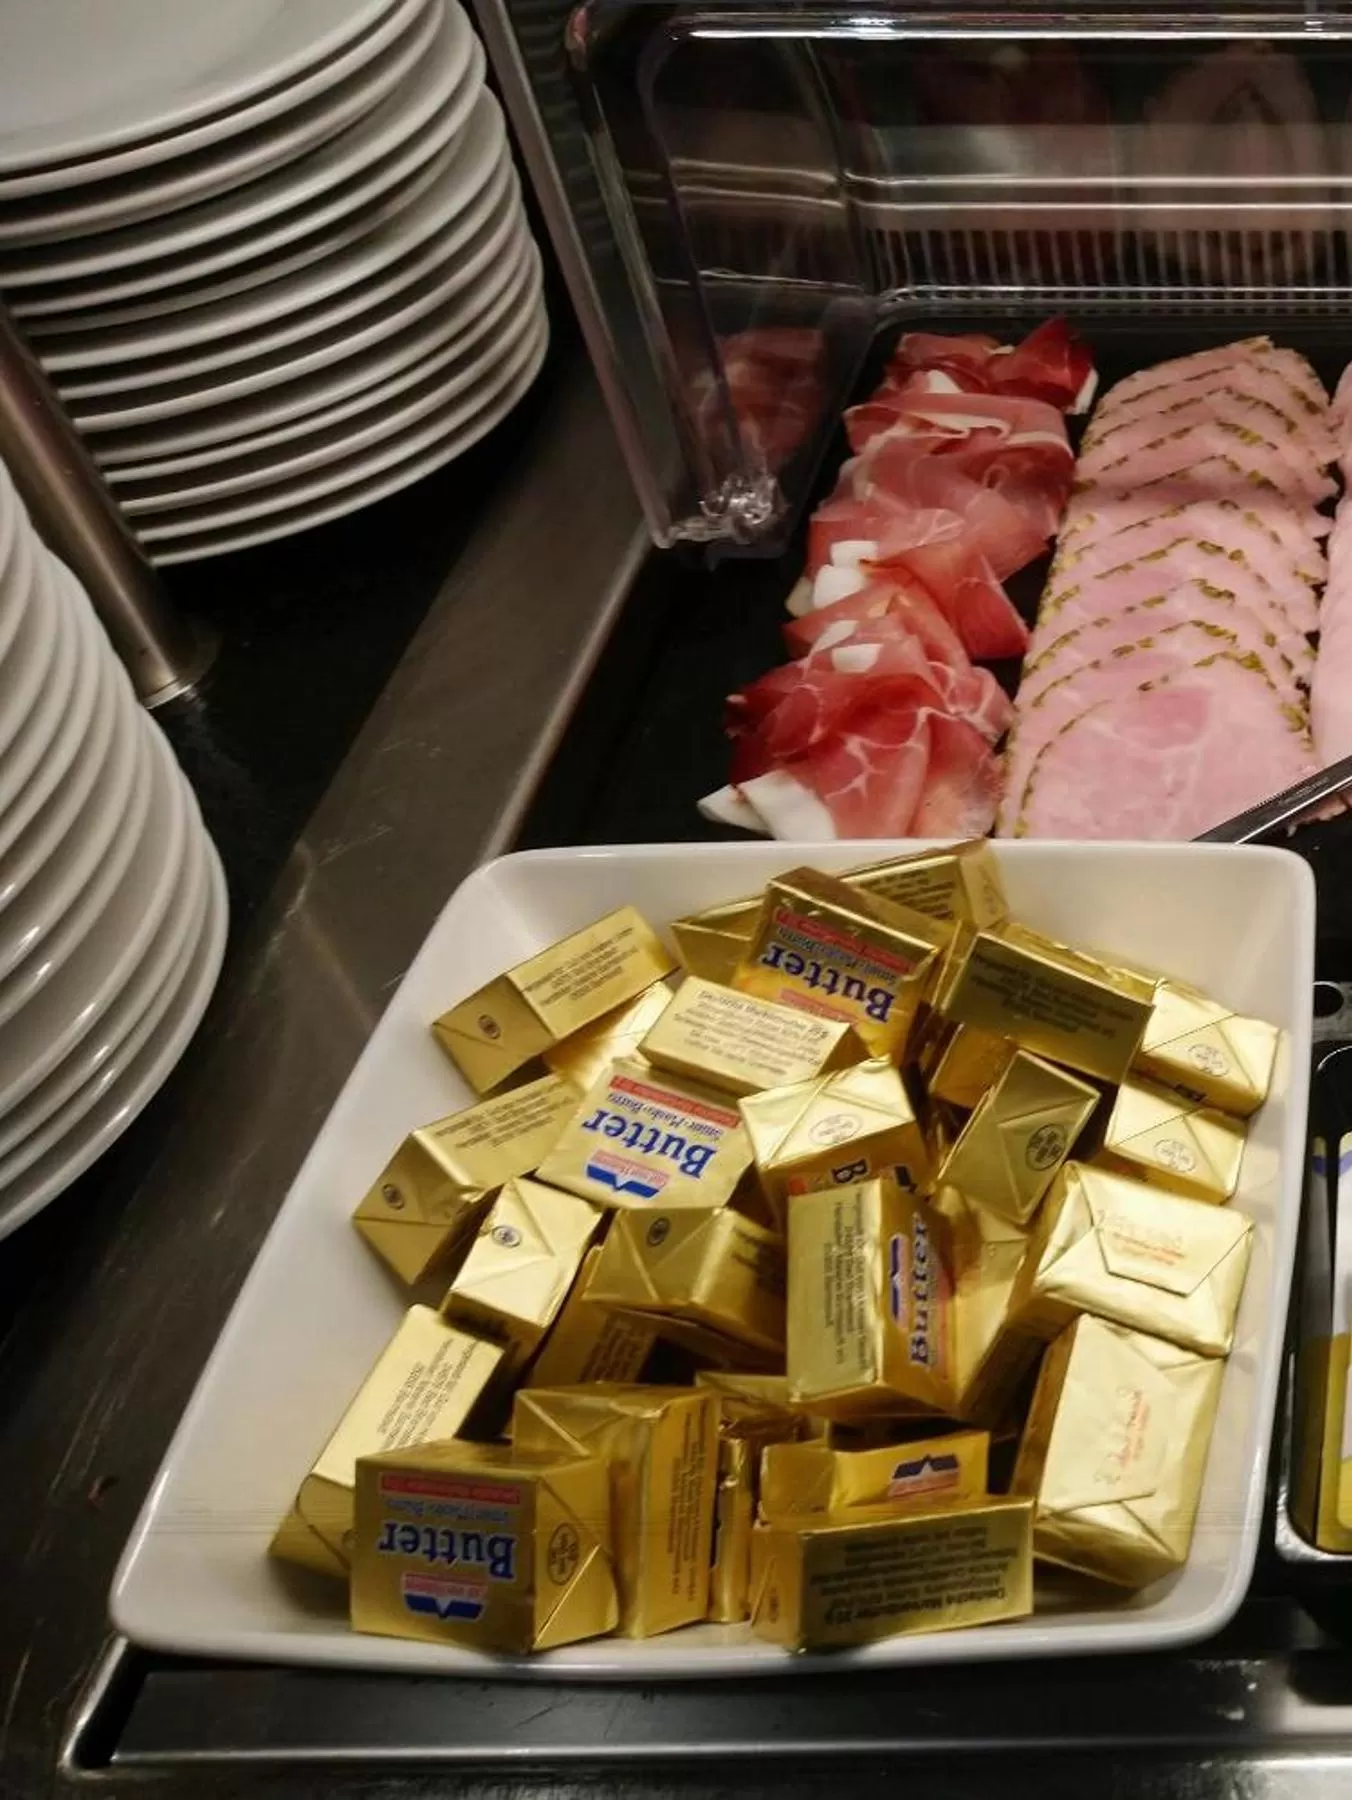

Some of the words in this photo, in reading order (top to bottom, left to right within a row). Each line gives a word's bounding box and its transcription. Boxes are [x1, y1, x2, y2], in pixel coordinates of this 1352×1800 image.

[759, 942, 895, 1025] Butter
[582, 1109, 717, 1178] Butter
[910, 1213, 937, 1367] Butter
[378, 1523, 517, 1579] Butter
